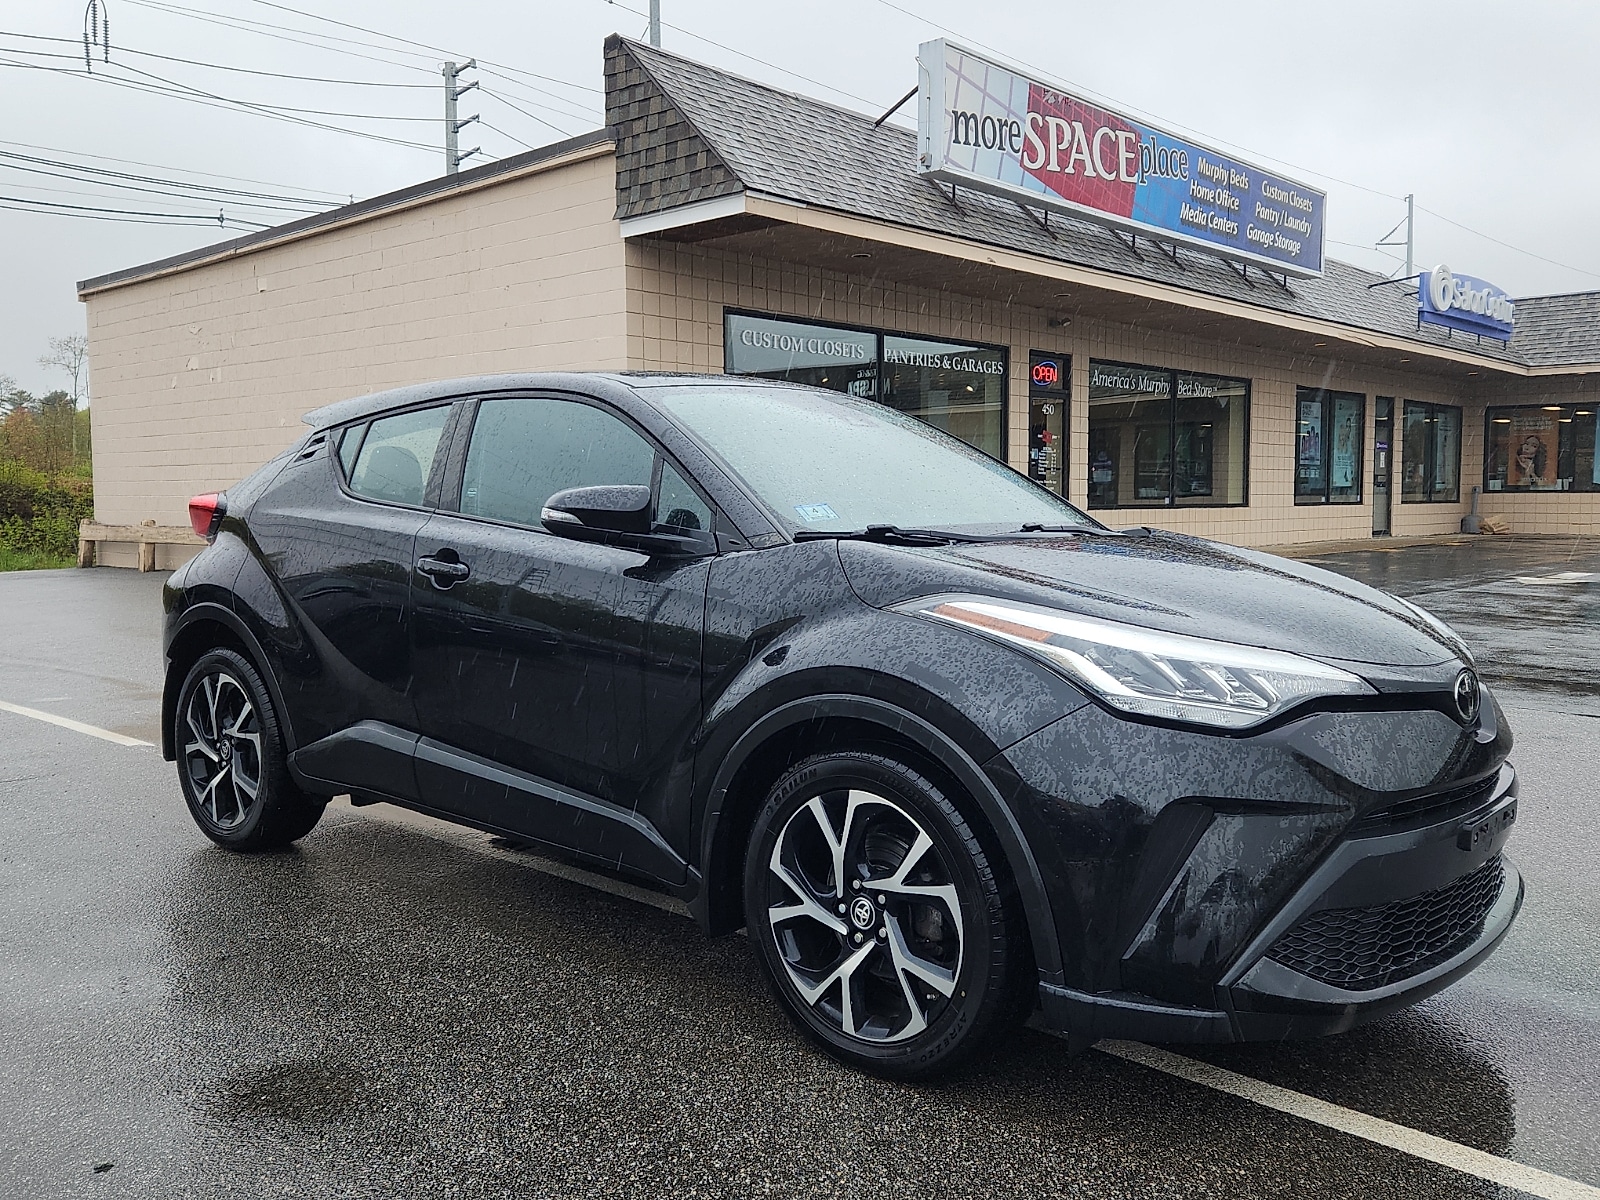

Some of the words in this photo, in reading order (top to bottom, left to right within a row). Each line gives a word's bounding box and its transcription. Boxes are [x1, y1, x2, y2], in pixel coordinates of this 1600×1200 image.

[1023, 111, 1138, 183] SPACE
[1198, 156, 1229, 186] Murphy
[1230, 168, 1249, 189] Beds
[1190, 179, 1214, 203] Home
[1216, 188, 1240, 210] Office
[1261, 180, 1289, 204] Custom
[1289, 191, 1313, 212] Closets
[1180, 202, 1207, 225] Media
[1208, 211, 1239, 235] Centers
[1255, 201, 1280, 227] Pantry
[1284, 210, 1312, 238] Laundry
[1247, 223, 1274, 248] Garage
[1274, 231, 1301, 257] Storage
[741, 329, 804, 353] CUSTOM
[808, 338, 865, 359] CLOSETS
[884, 348, 940, 368] PANTRIES
[942, 355, 951, 369] &
[952, 356, 1004, 375] GARAGES
[1033, 365, 1058, 382] OPEN
[1091, 369, 1136, 390] America's
[1138, 375, 1171, 397] Murphy
[1177, 379, 1193, 396] Bed
[1042, 403, 1055, 416] 450
[920, 1011, 967, 1063] ATREZZO
